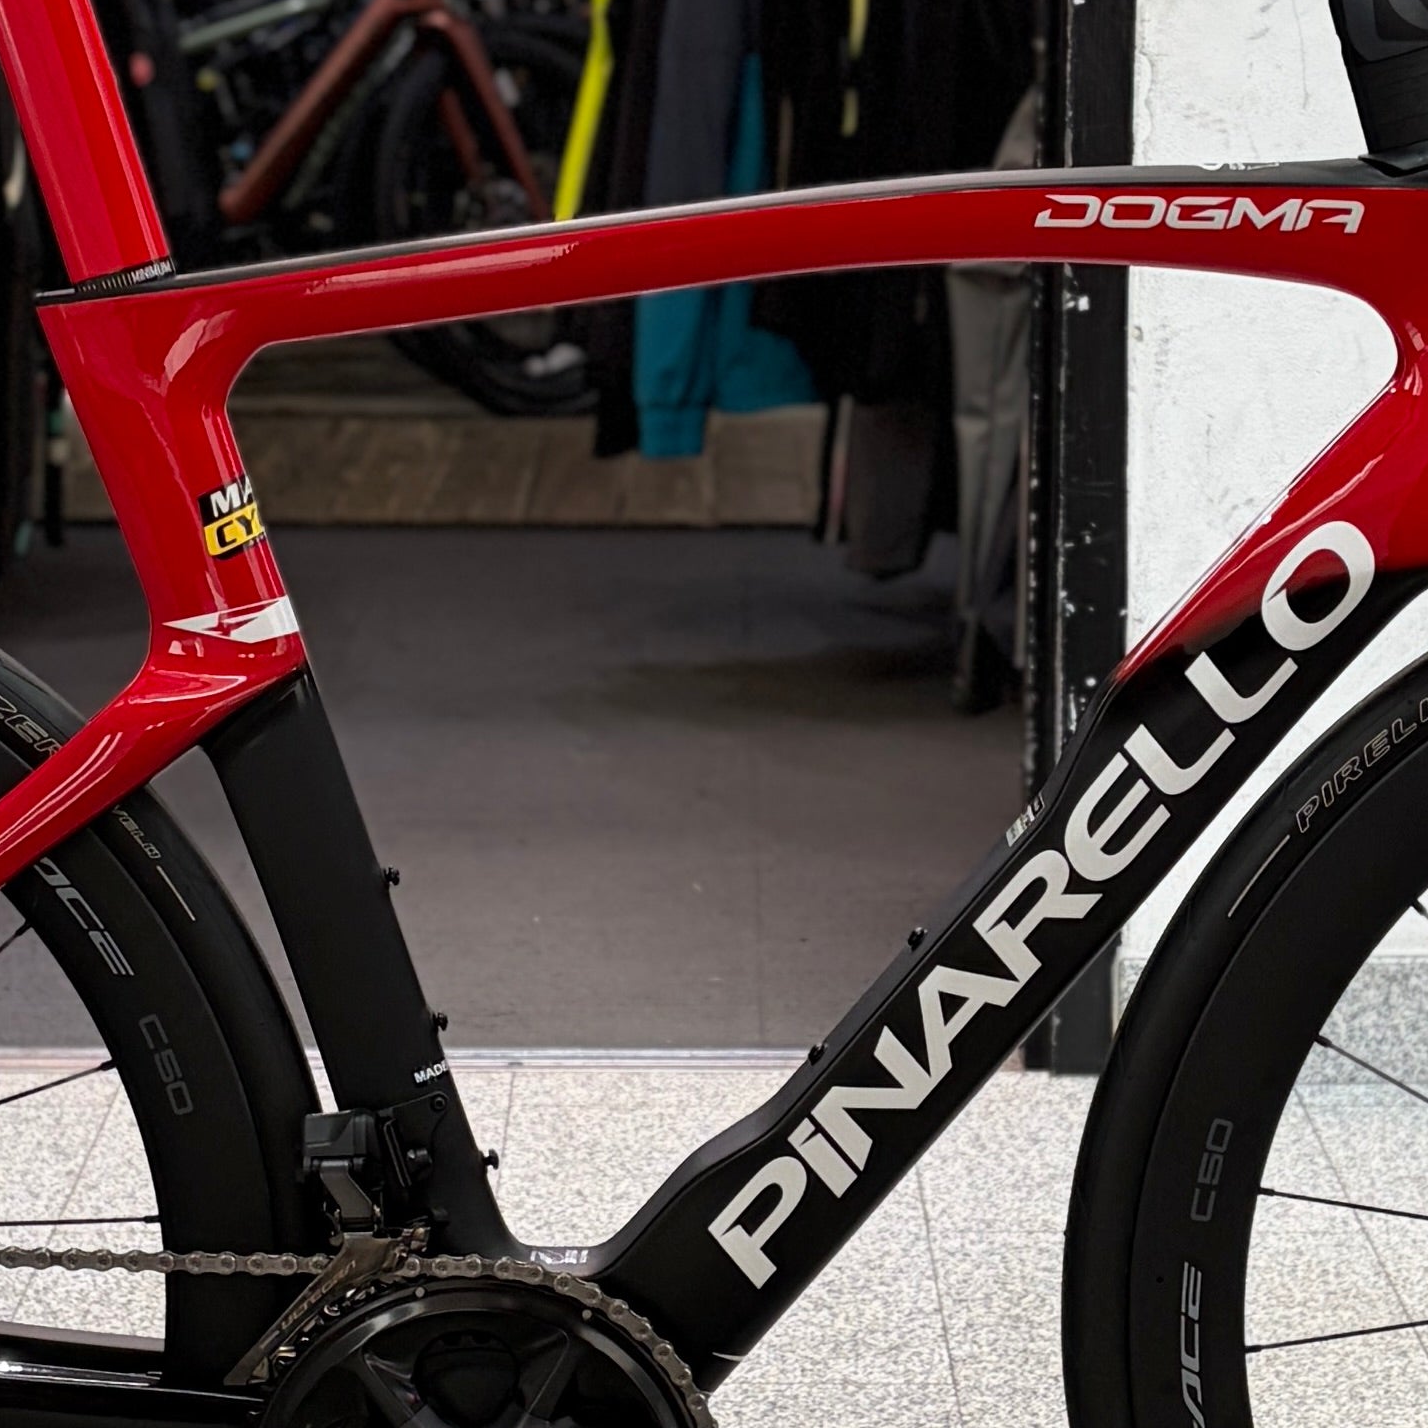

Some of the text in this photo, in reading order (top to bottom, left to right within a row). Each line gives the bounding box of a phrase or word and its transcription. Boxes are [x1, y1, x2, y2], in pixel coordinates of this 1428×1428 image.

[1033, 194, 1365, 234] DOGMA
[217, 506, 264, 548] CY
[708, 520, 1376, 1290] PINARELLO
[139, 1014, 194, 1116] C50
[1190, 1118, 1233, 1222] C50
